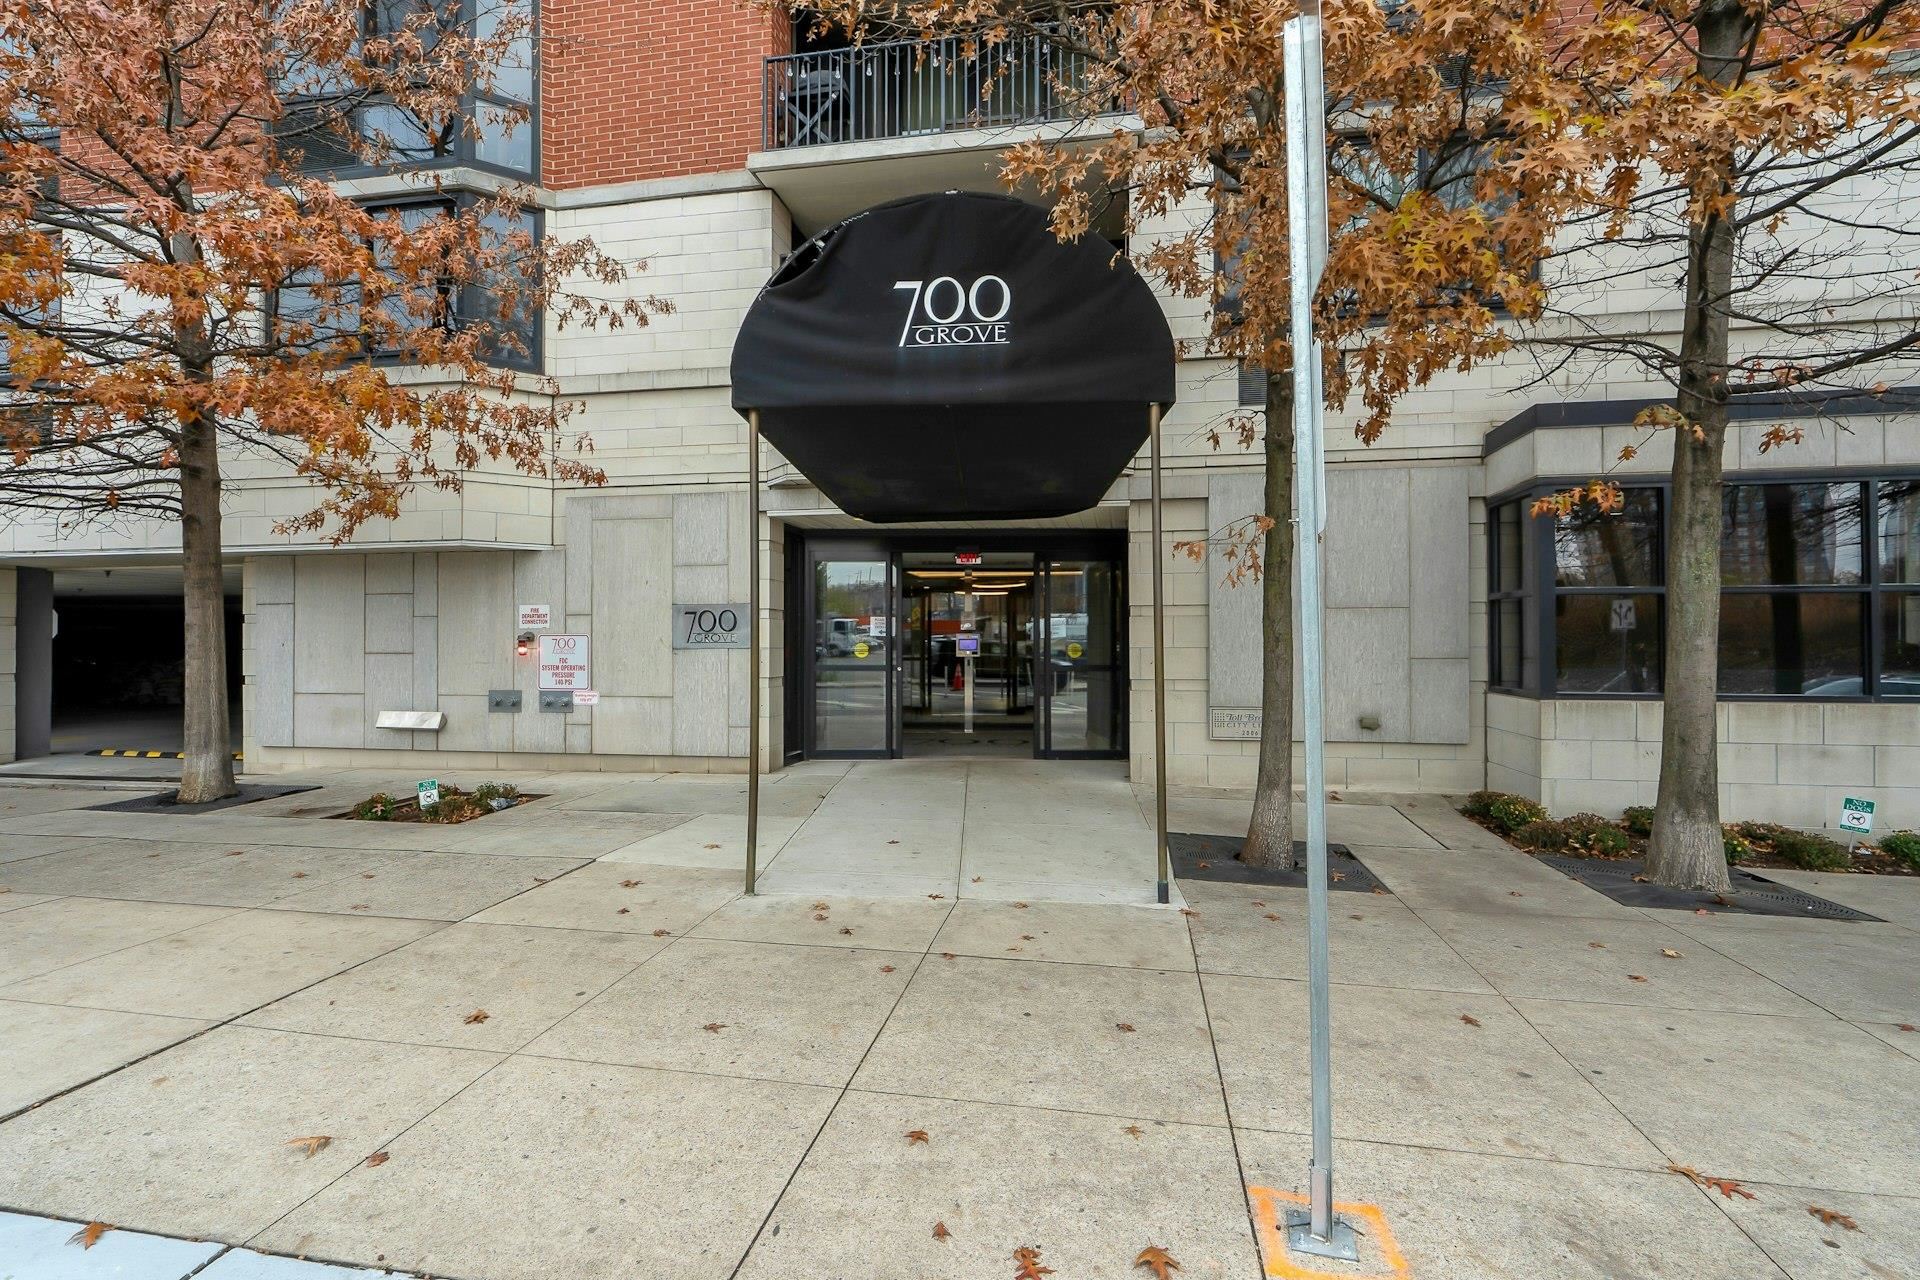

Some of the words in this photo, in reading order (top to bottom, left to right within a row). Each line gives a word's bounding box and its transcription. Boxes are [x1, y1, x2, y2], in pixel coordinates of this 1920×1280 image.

[894, 275, 1011, 347] 700
[916, 325, 1006, 344] GROVE
[684, 610, 737, 643] 700
[552, 638, 576, 654] 700
[694, 634, 736, 642] GROVE
[1846, 804, 1871, 812] DOGS
